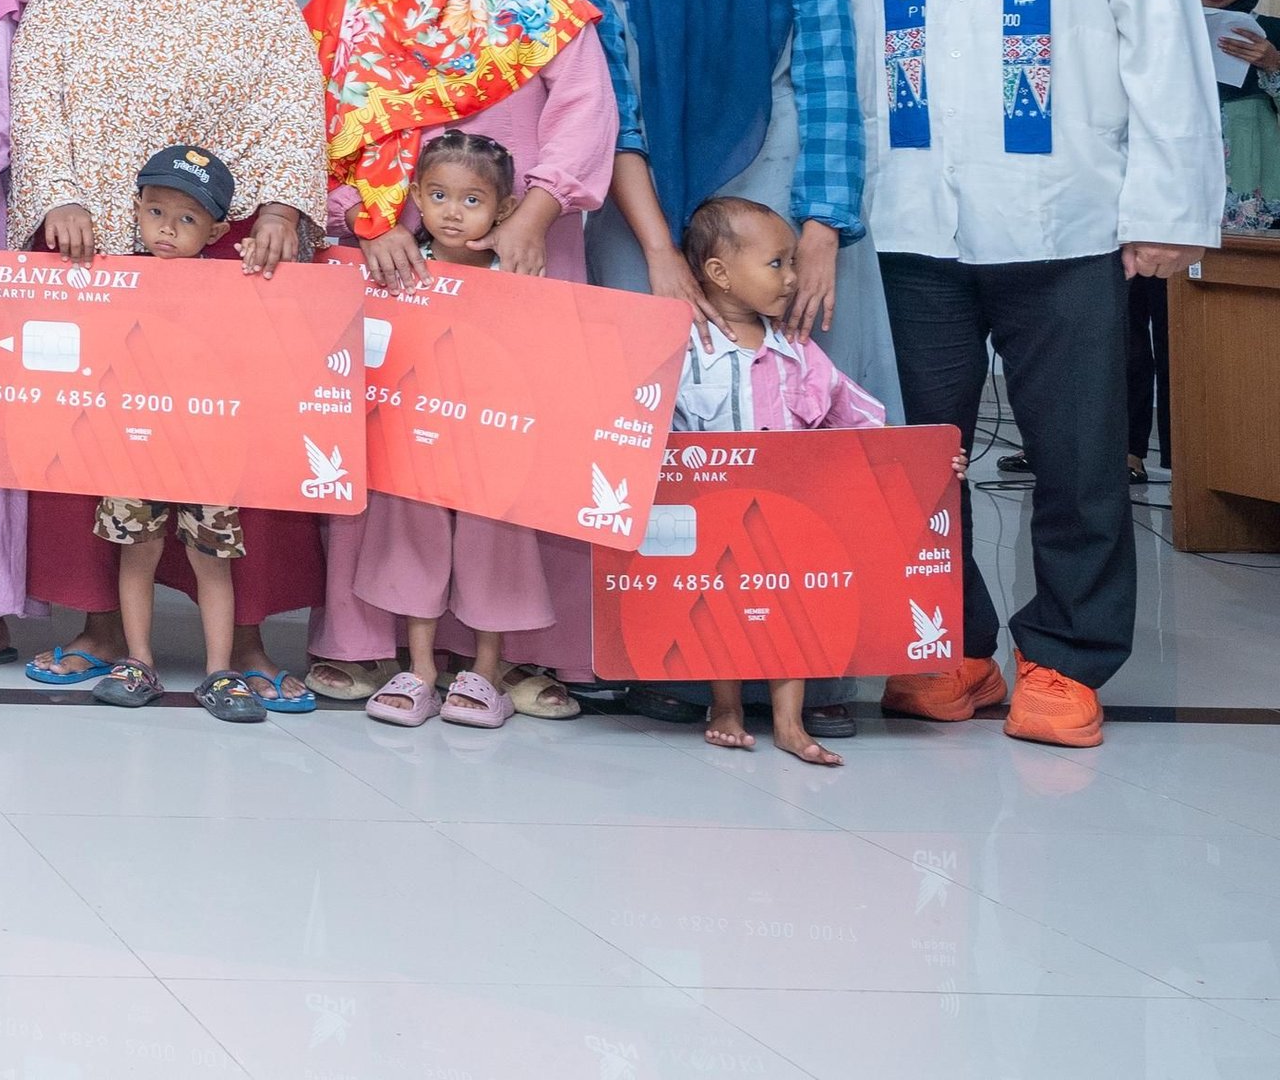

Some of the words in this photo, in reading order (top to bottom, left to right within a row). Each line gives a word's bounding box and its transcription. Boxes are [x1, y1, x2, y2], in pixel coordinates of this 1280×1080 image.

[172, 158, 210, 183] Teddy
[93, 270, 141, 289] DKI
[44, 290, 68, 300] PKD
[77, 292, 111, 302] ANAK
[365, 287, 388, 299] PKD
[397, 293, 430, 306] ANAK
[314, 386, 352, 400] debit
[56, 389, 107, 408] 4856
[121, 393, 173, 412] 2900
[188, 397, 241, 416] 0017
[299, 399, 352, 415] prepaid
[366, 385, 402, 406] 856
[415, 395, 467, 419] 2900
[480, 409, 536, 434] 0017
[125, 427, 152, 435] MEMBER
[413, 428, 439, 439] MEMBER
[614, 416, 654, 435] debit
[128, 434, 149, 442] SINCE
[415, 436, 434, 445] SINCE
[594, 428, 652, 449] prepaid
[708, 448, 758, 466] DKI
[658, 472, 683, 481] PKD
[694, 472, 728, 481] ANAK
[301, 478, 353, 501] GPN
[577, 507, 633, 537] GPN
[919, 548, 951, 561] debit
[905, 562, 952, 577] prepaid
[605, 574, 657, 591] 5049
[673, 573, 725, 590] 4856
[739, 573, 790, 590] 2900
[804, 572, 853, 589] 0017
[907, 640, 952, 660] GPN
